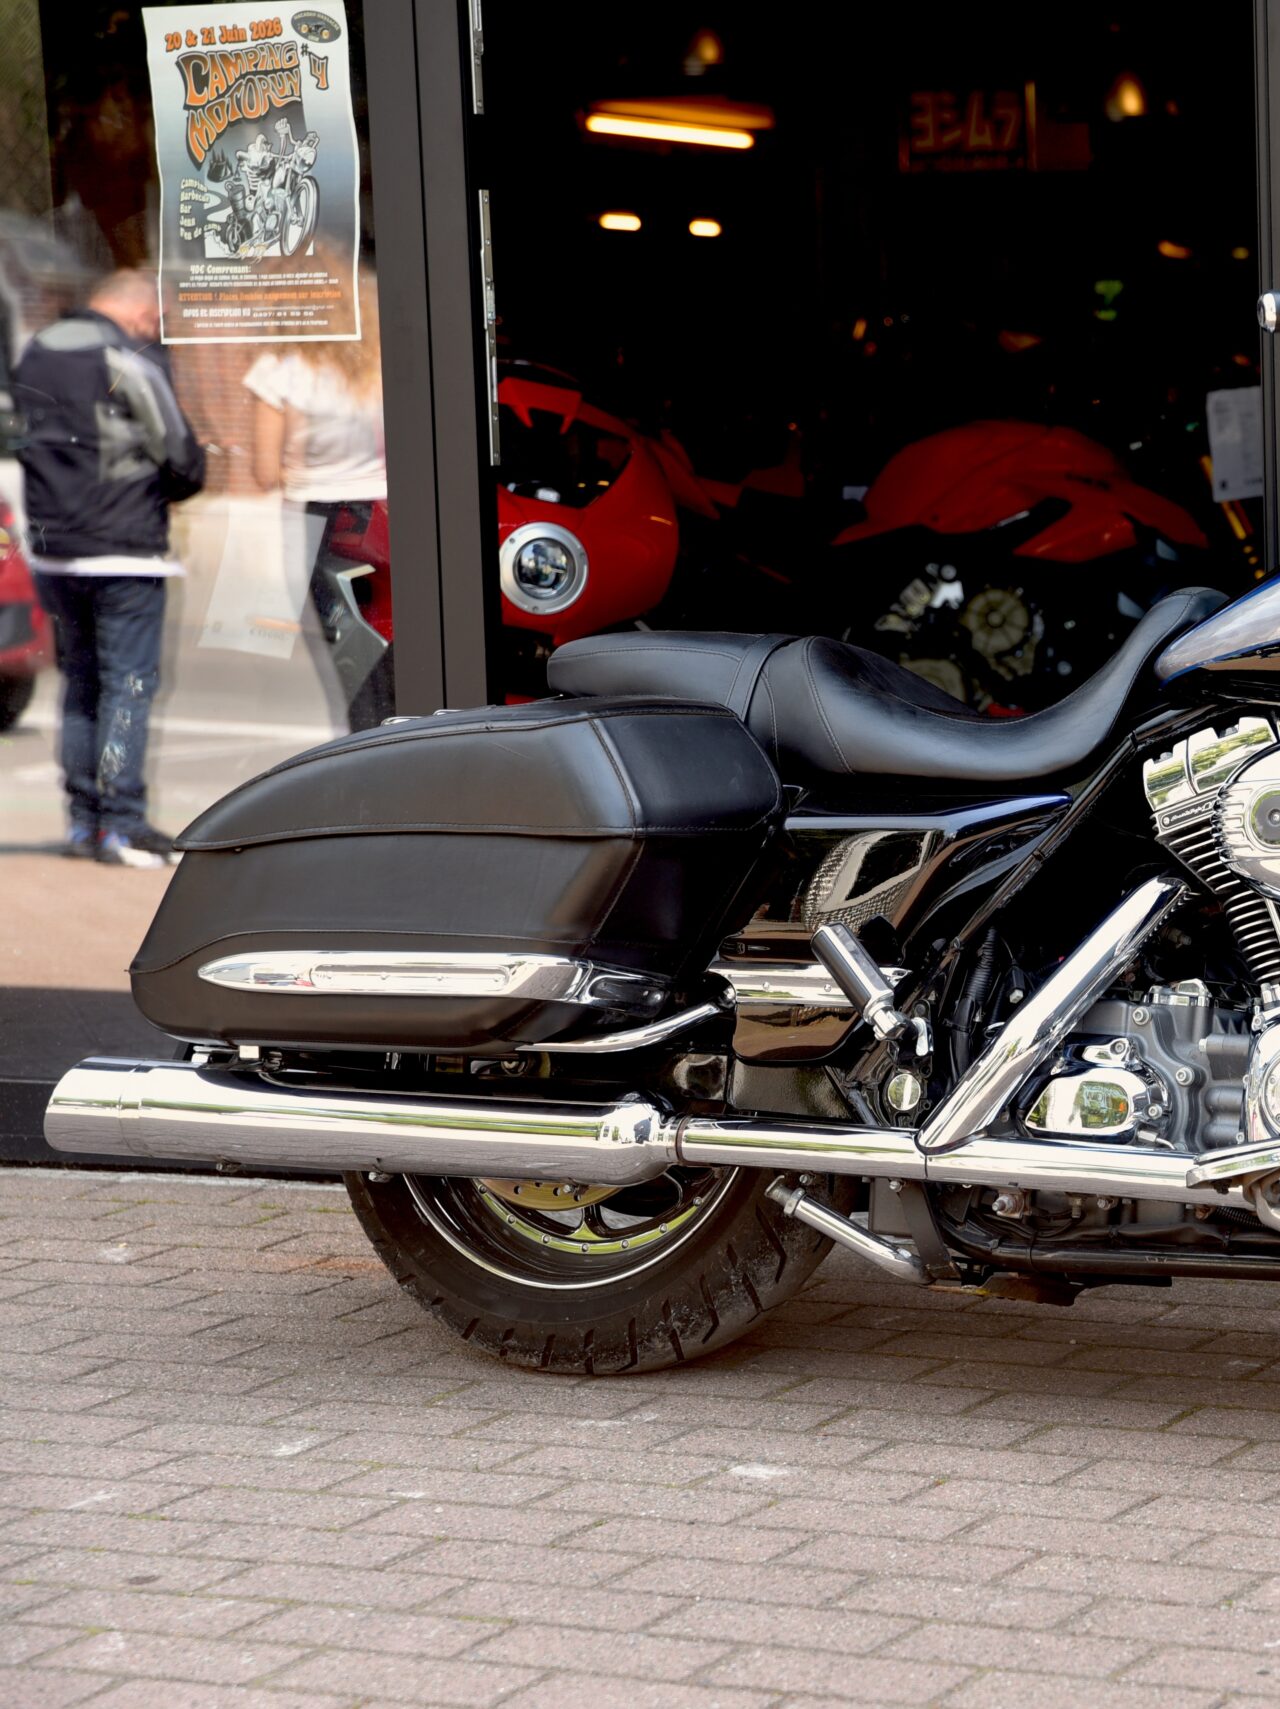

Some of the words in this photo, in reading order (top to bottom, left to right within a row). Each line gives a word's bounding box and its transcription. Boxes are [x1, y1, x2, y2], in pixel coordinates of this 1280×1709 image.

[165, 32, 182, 52] 20
[185, 29, 197, 47] &
[201, 27, 216, 45] 21
[220, 24, 247, 43] Juin
[250, 16, 283, 41] 2026
[177, 41, 299, 107] CAMPING
[187, 68, 302, 165] MOTORUN
[180, 203, 192, 213] Bar
